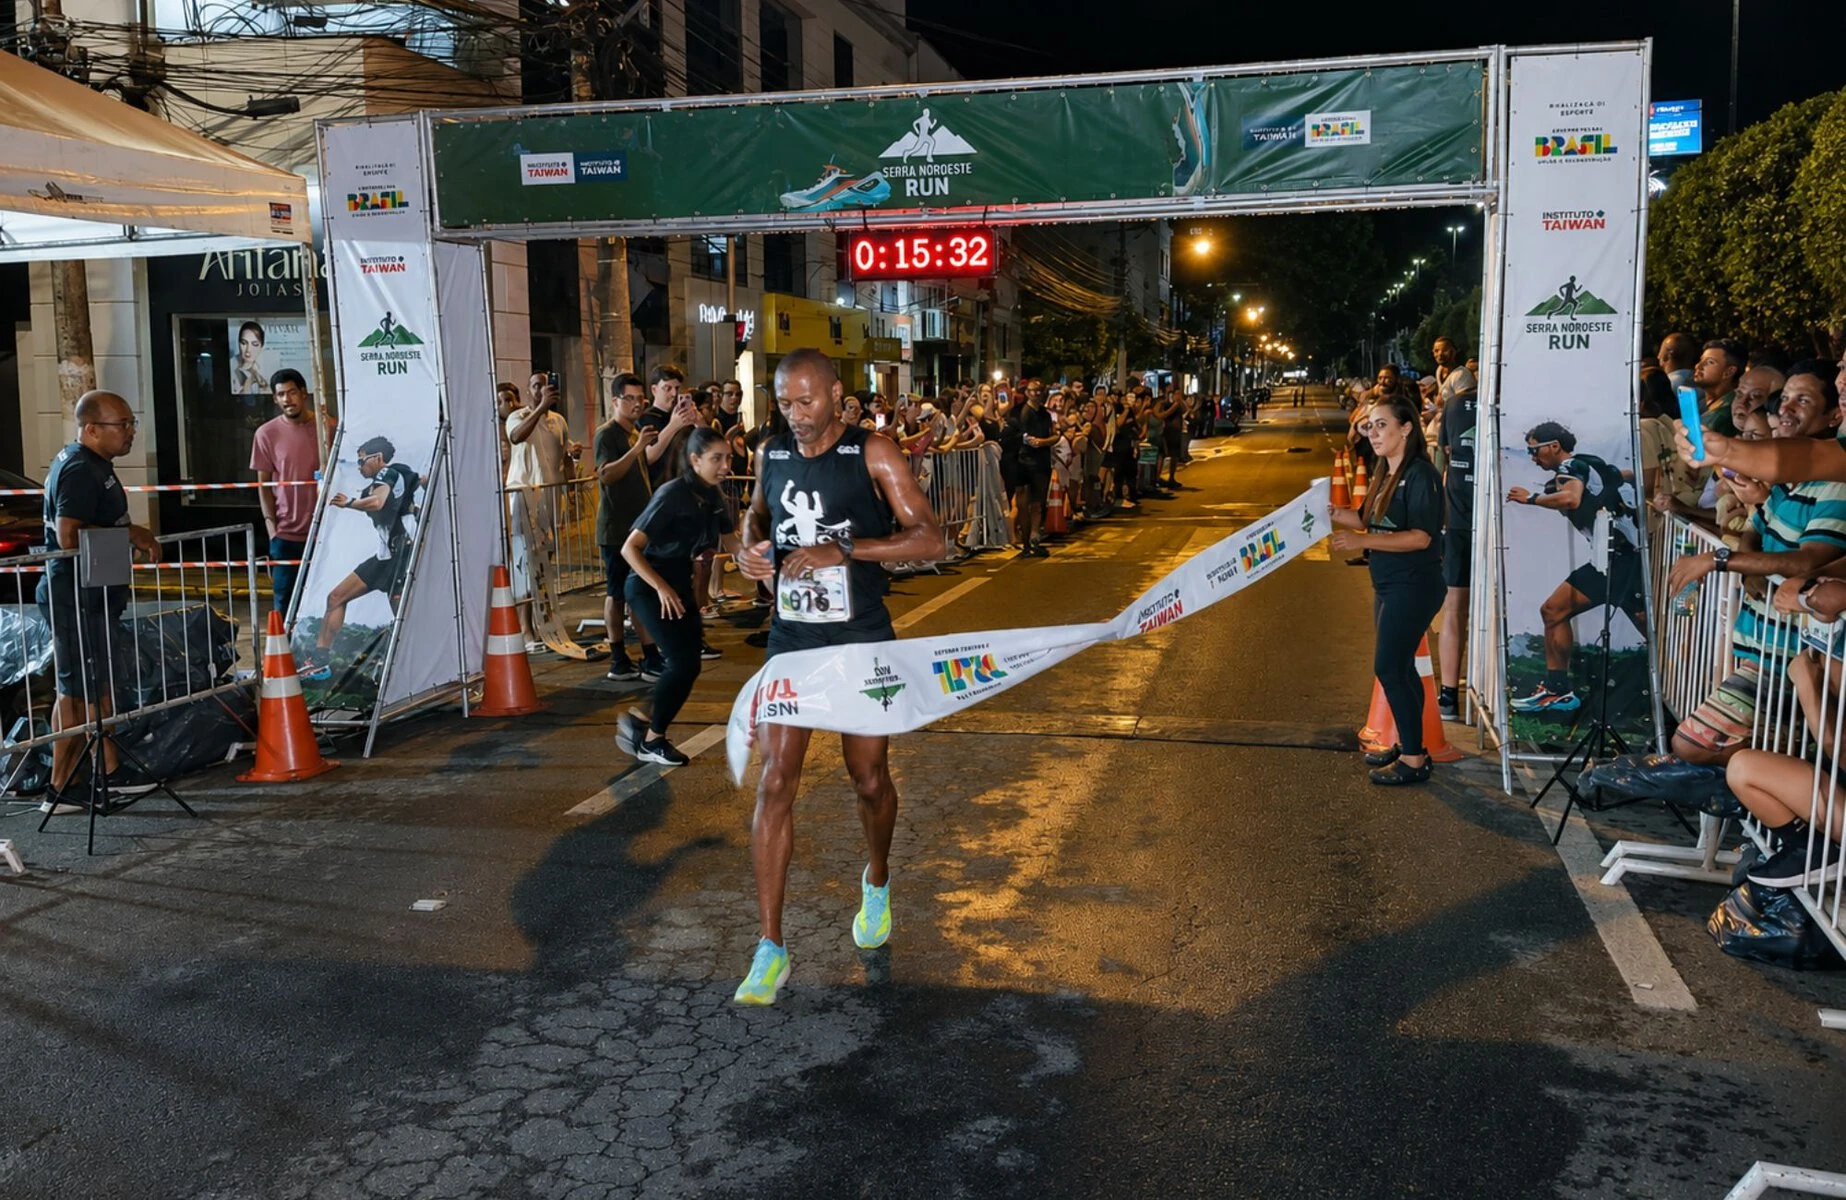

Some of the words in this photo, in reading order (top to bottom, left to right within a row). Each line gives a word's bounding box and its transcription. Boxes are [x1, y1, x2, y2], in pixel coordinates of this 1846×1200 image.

[1535, 133, 1618, 157] BRASIL
[527, 168, 568, 177] TAIWAN
[580, 166, 621, 175] TAIWAN
[882, 165, 917, 178] SERRA
[918, 162, 973, 177] NOROESTE
[905, 176, 949, 197] RUN
[1542, 210, 1594, 219] INSTITUTO
[1542, 219, 1605, 231] TAIWAN
[855, 236, 988, 271] 0:15:32
[360, 263, 406, 274] TAIWAN
[236, 282, 303, 296] JOIAS
[1526, 323, 1559, 333] SERRA
[1560, 321, 1613, 333] NOROESTE
[1549, 334, 1590, 350] RUN
[377, 360, 408, 375] RUN
